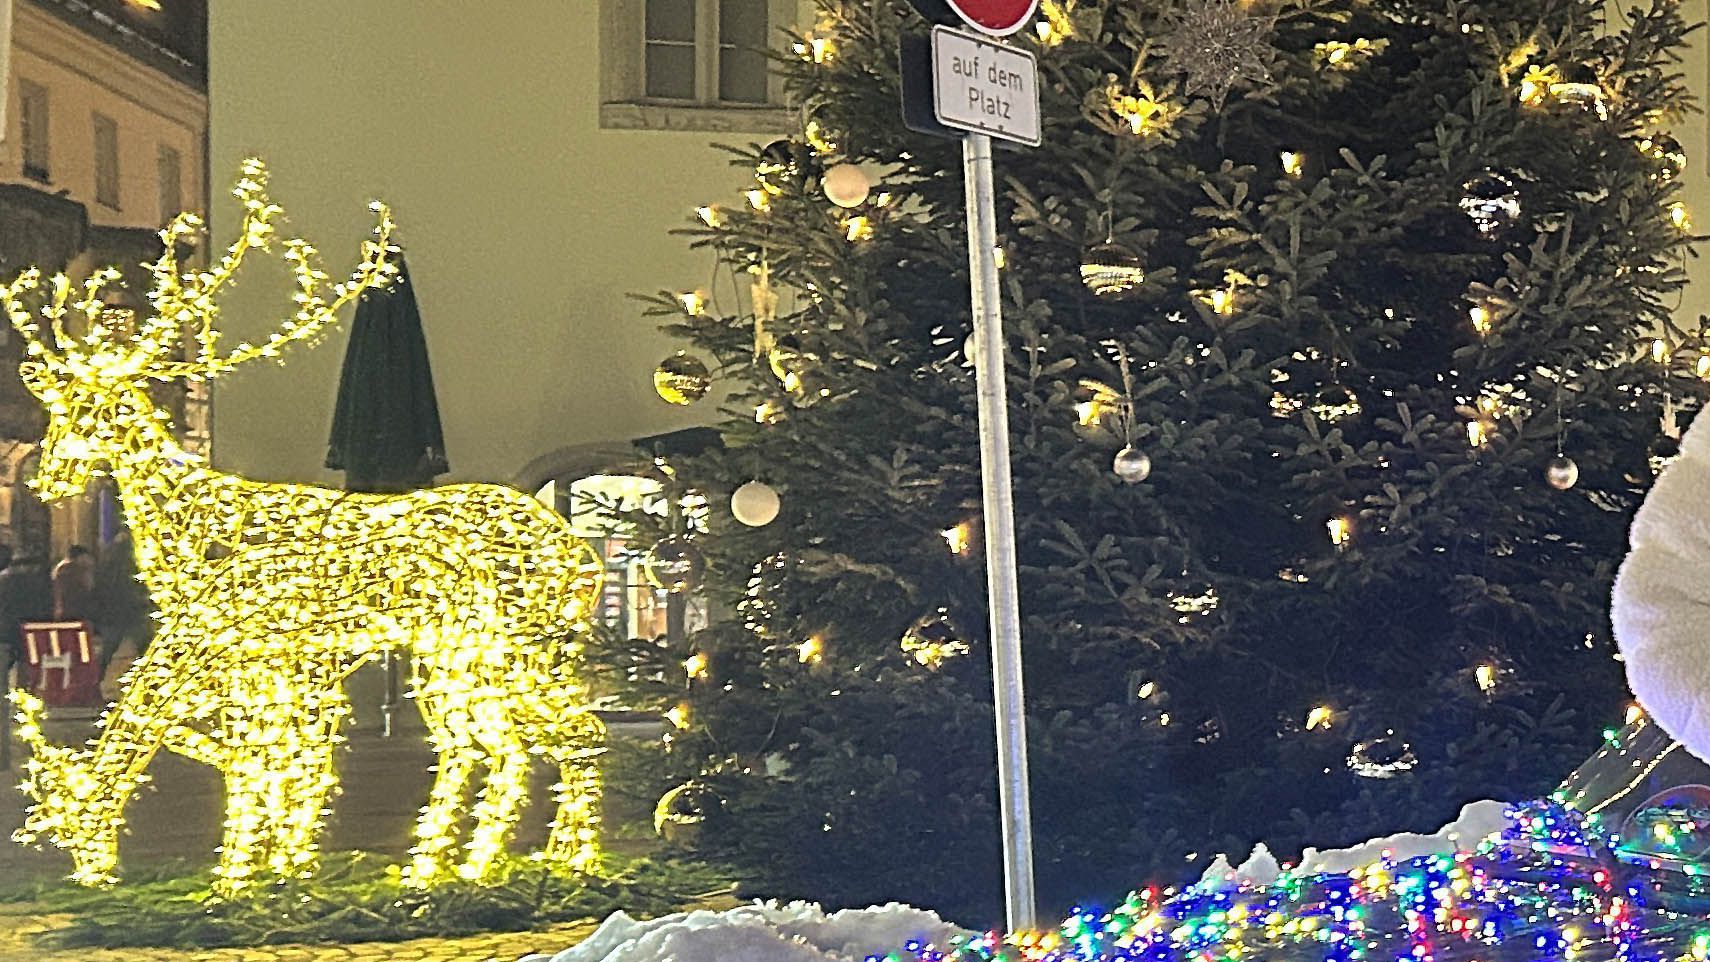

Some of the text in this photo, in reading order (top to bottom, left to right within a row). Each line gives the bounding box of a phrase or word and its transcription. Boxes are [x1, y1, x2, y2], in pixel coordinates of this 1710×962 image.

[952, 56, 1023, 92] auf dem
[968, 86, 1011, 119] Platz
